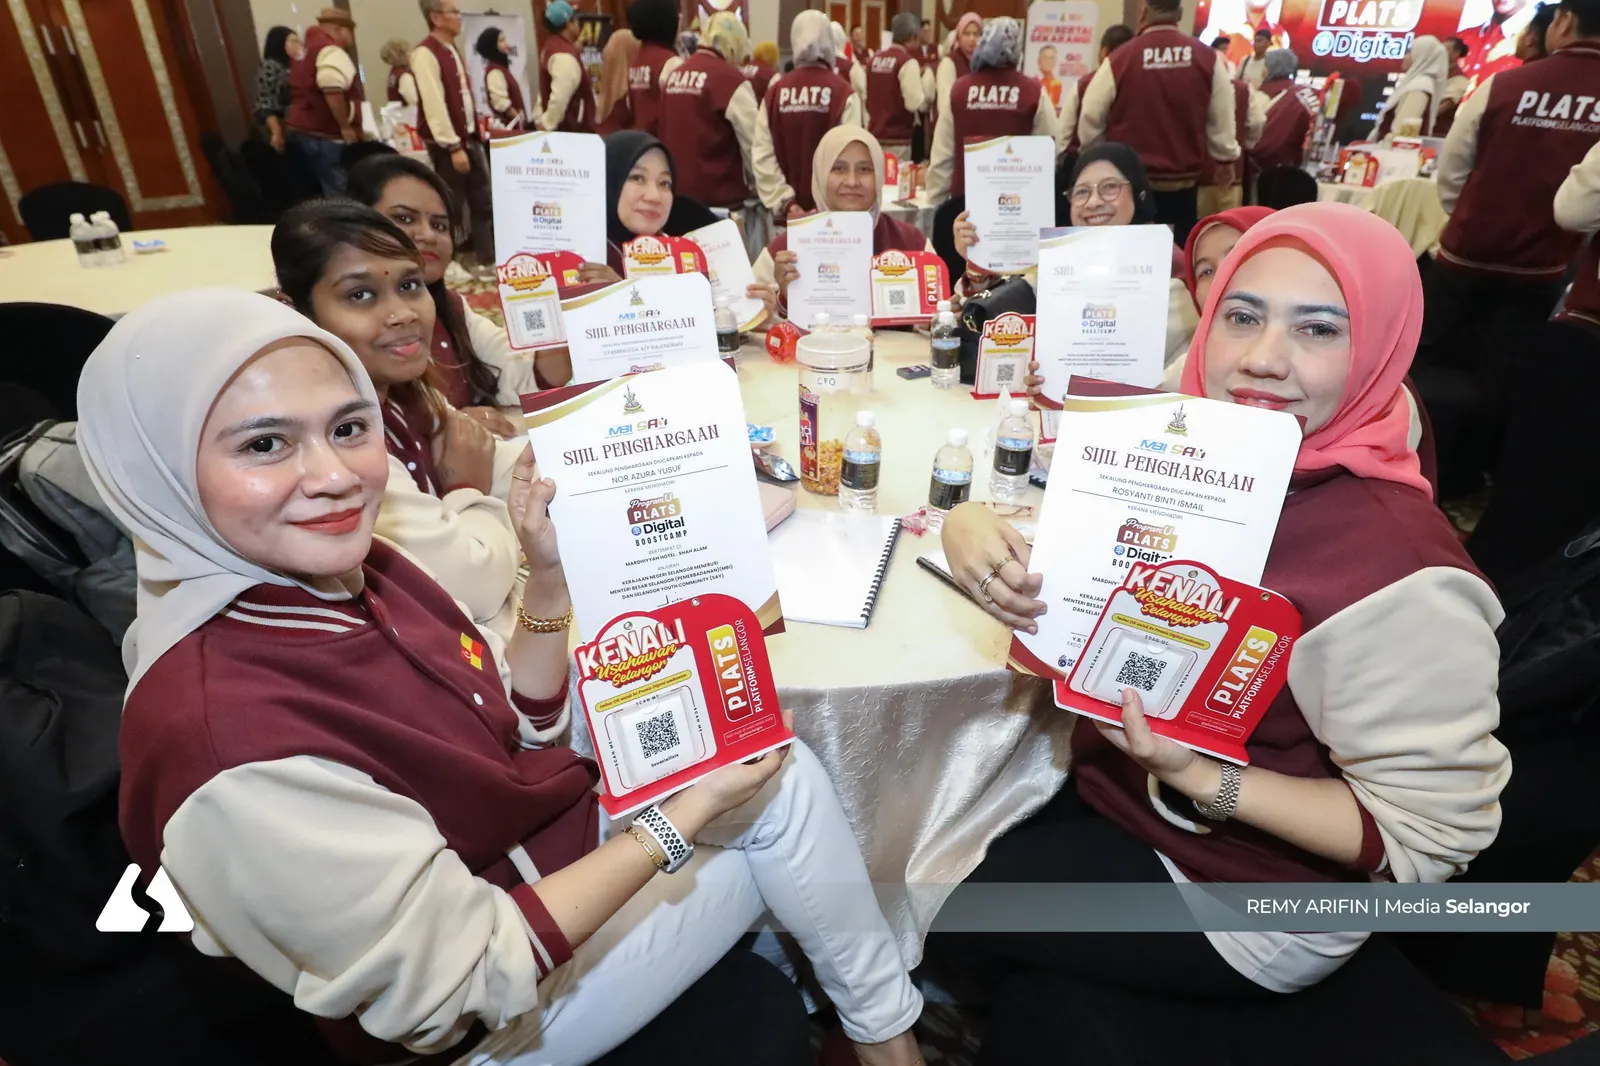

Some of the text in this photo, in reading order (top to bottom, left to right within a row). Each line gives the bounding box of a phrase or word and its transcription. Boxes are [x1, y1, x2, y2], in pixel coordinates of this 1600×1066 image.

[1329, 0, 1414, 25] PLATS
[1143, 47, 1192, 62] PLATS
[1336, 33, 1412, 60] Digital
[667, 71, 708, 88] PLATS
[779, 87, 832, 105] PLATS
[968, 85, 1020, 103] PLATS
[622, 242, 672, 258] KENALI
[496, 259, 553, 282] KENALI
[872, 256, 916, 268] KENALI
[585, 317, 696, 340] SIJIL PENGHARGAAN
[985, 322, 1035, 336] KENALI
[1089, 320, 1116, 329] Digital
[608, 424, 633, 436] MBI
[562, 424, 720, 466] SIJIL PENGHARGAAN
[1139, 439, 1168, 452] MBI
[587, 450, 704, 478] SEKALUNG PENGHARGAAN DIUCAPKAN KEPADA
[611, 464, 683, 484] NOR AZURA YUSUF
[1082, 445, 1256, 493] SIJIL PENGHARGAAN
[624, 479, 676, 494] KERANA MENGHADIRI
[1099, 473, 1227, 504] SEKALUNG PENGHARGAAN DIUCAPKAN KEPADA
[630, 496, 664, 510] Program
[1112, 486, 1205, 512] ROSYANTI BINTI ISMAIL
[633, 503, 676, 522] PLATS
[1127, 505, 1184, 520] KERANA MENGHADIRI
[643, 516, 686, 535] Digital
[1126, 518, 1164, 534] Program
[635, 529, 688, 547] BOOSTCAMP
[1123, 530, 1171, 550] PLATS
[625, 556, 660, 567] MARDHIYYAH
[660, 552, 676, 560] HOTEL
[693, 545, 708, 553] ALAM
[621, 561, 719, 585] KERAJAAN NEGERI SELANGOR MENERUSI
[657, 563, 680, 571] ANJURAN
[609, 587, 632, 595] MENTERI
[648, 578, 675, 587] SELANGOR
[634, 588, 661, 597] SELANGOR
[678, 577, 709, 588] COMMUNITY
[1126, 566, 1241, 621] KENALI
[1063, 597, 1087, 606] MENTERI
[1134, 587, 1217, 622] Usahawan
[1141, 603, 1199, 627] Selangor
[578, 617, 687, 678] KENALI
[595, 643, 677, 680] Usahawan
[734, 617, 764, 713] PLATFORMSELANGOR
[1212, 637, 1269, 706] PLATS
[611, 659, 669, 687] Selangor
[713, 635, 748, 711] PLATS
[1231, 635, 1293, 720] PLATFORMSELANGOR
